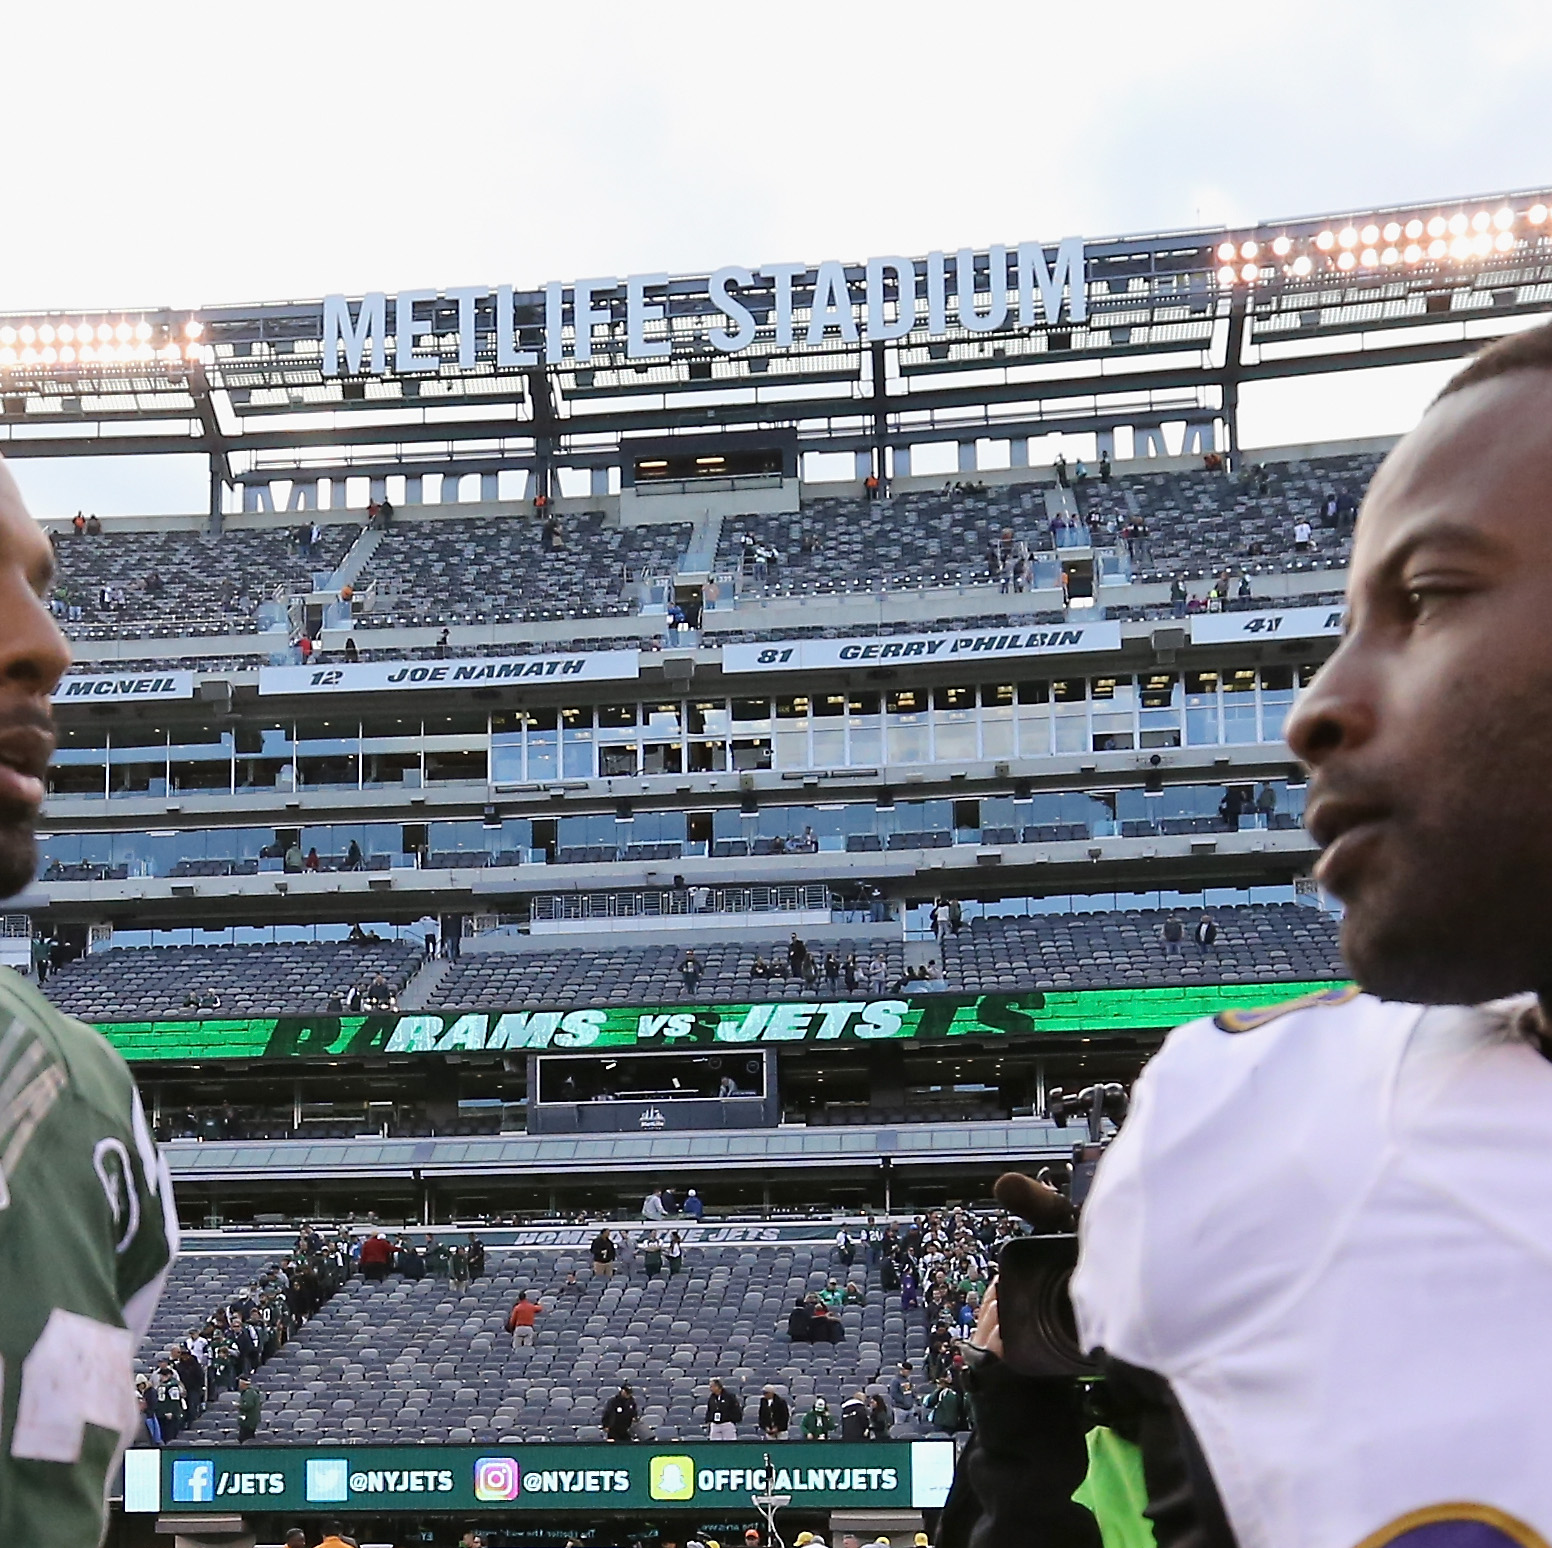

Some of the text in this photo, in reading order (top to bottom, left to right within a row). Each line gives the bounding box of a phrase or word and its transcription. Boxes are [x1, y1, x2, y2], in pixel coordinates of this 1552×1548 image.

[322, 237, 1091, 376] METLIFE STADIUM
[756, 630, 1084, 664] 81 GERRY PHILBIN
[310, 659, 586, 686] 12 JOE NAMATH
[65, 677, 177, 696] MCNEIL
[384, 1000, 909, 1053] RAMS VS JETS
[514, 1230, 600, 1246] HOME
[708, 1227, 781, 1242] JETS
[216, 1471, 285, 1496] /JETS
[349, 1470, 454, 1493] @NYJETS
[523, 1469, 631, 1493] @NYJETS
[698, 1468, 898, 1492] OFFICALNYJETS
